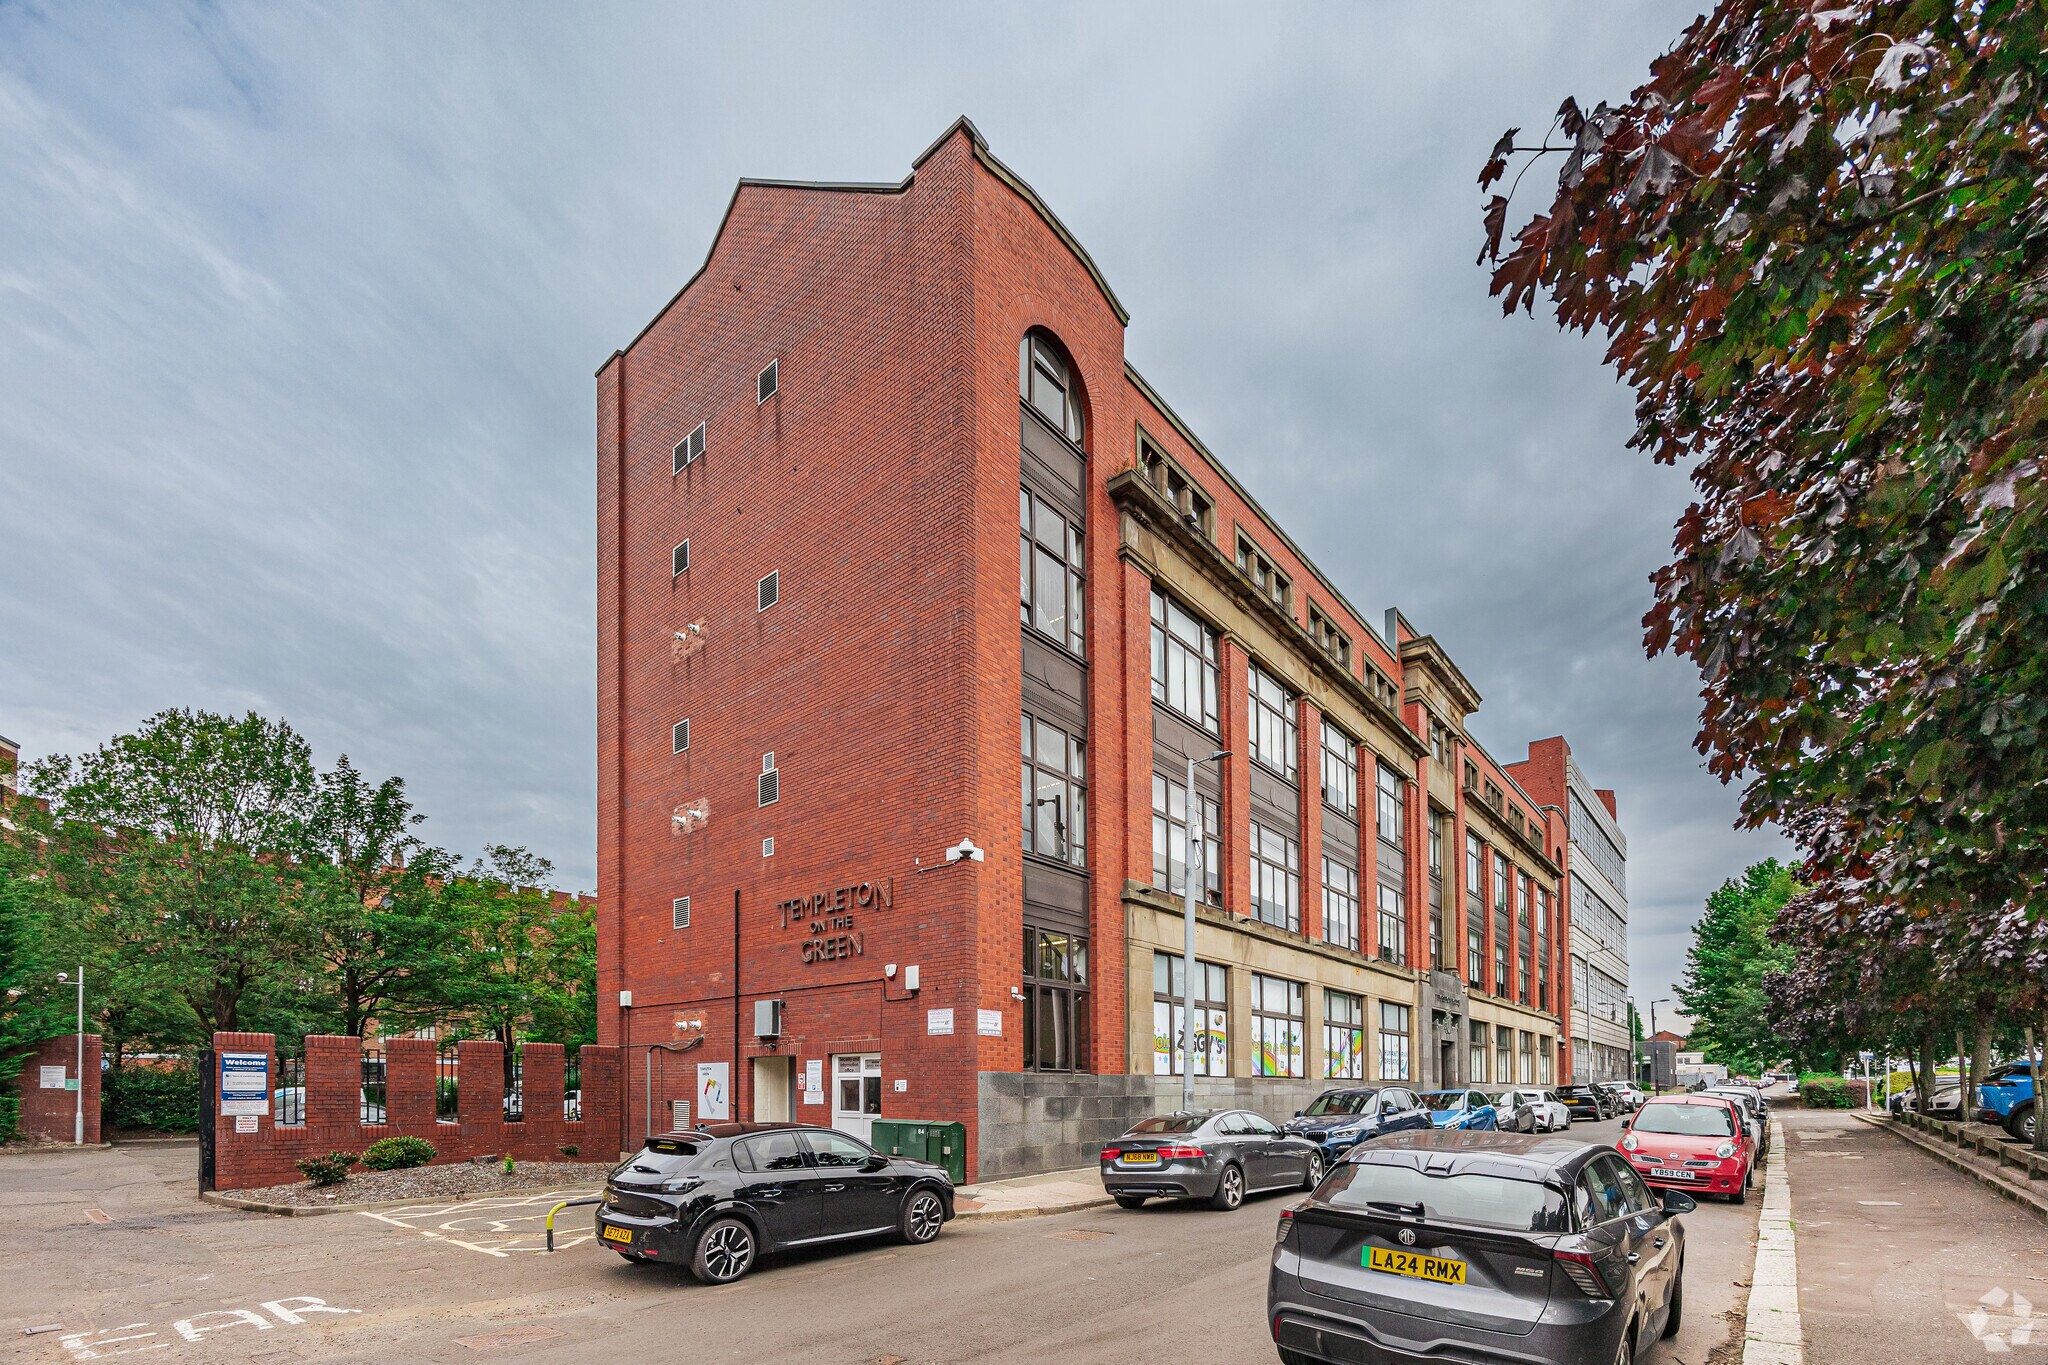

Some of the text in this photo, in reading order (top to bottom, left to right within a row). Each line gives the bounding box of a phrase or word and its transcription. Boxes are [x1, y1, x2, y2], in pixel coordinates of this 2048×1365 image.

[775, 876, 894, 928] TEMPLETON
[809, 913, 853, 933] ON THE
[801, 932, 864, 963] GREEN
[1654, 1168, 1691, 1178] YB59 CEN
[1399, 1229, 1416, 1245] MG
[1372, 1249, 1462, 1281] LA24 RMX
